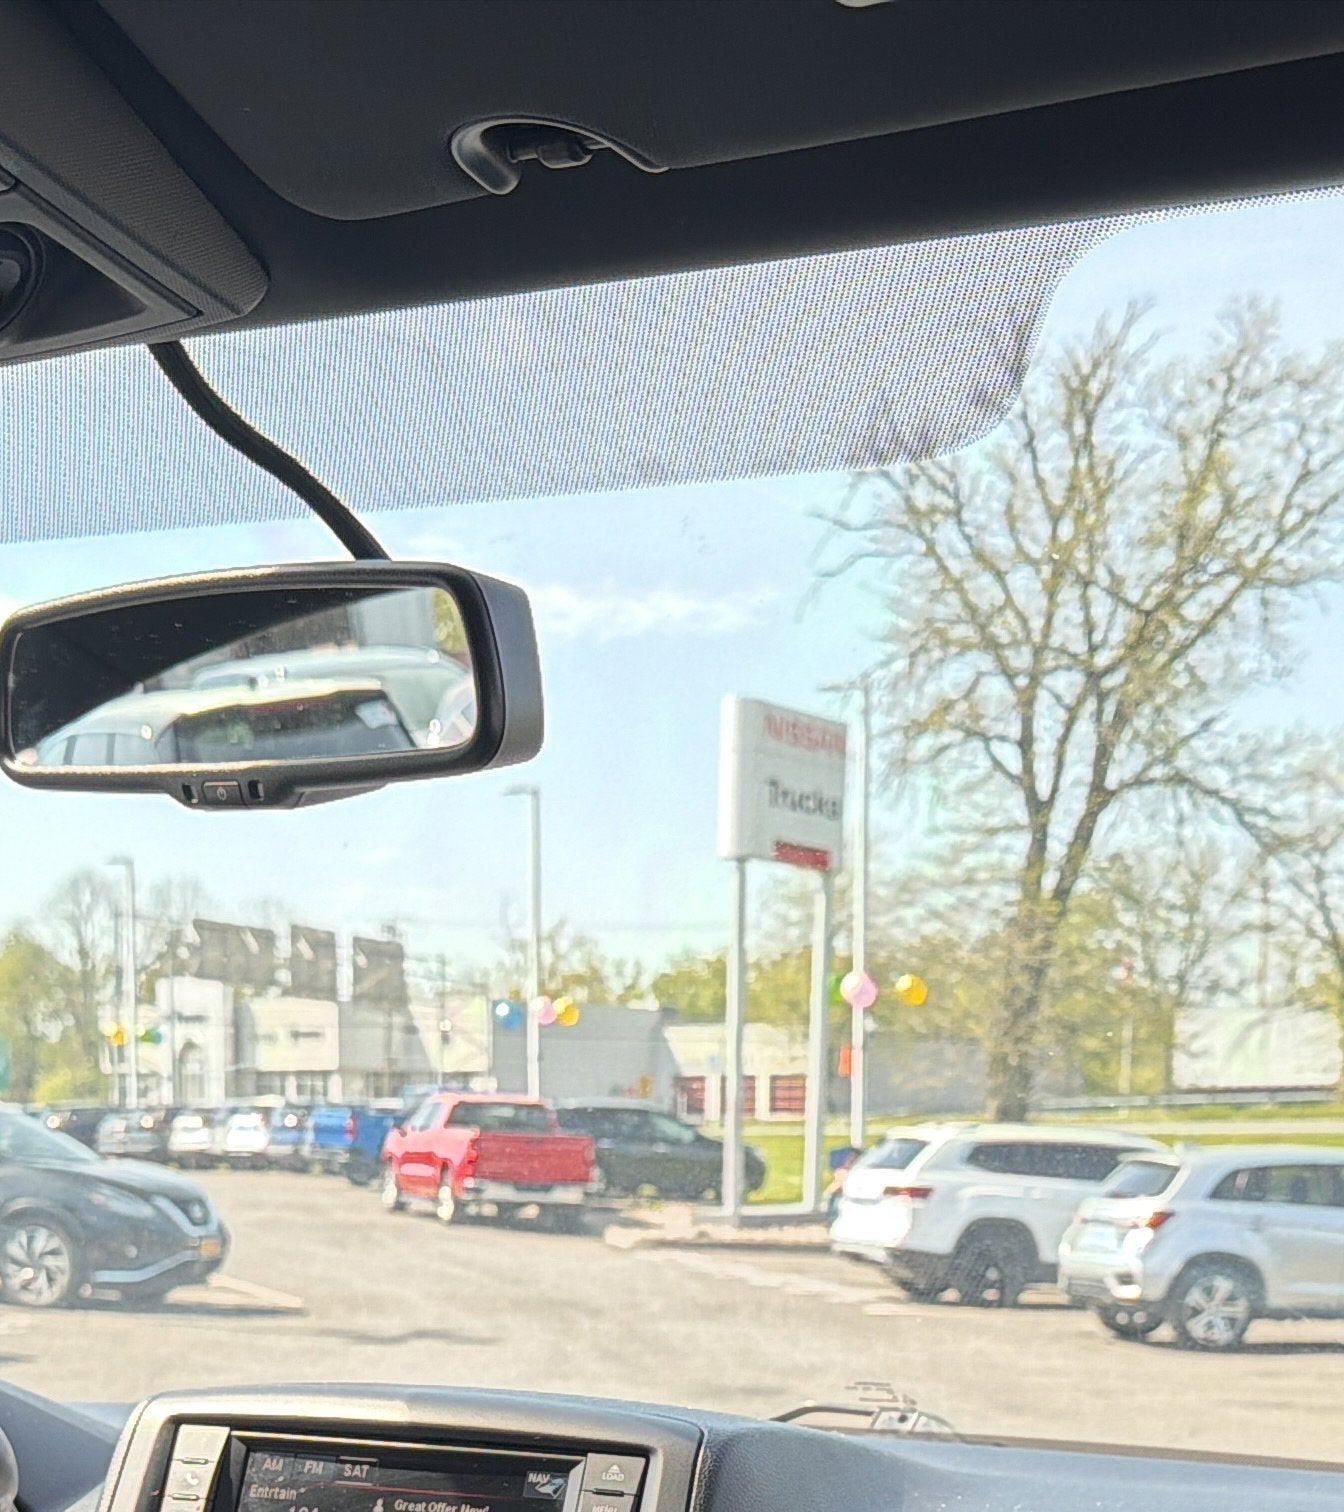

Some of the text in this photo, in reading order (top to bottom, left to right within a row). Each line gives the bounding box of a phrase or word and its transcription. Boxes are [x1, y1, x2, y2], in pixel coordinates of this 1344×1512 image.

[262, 1457, 369, 1478] AM FM SAT
[528, 1473, 550, 1483] NAV
[250, 1484, 297, 1500] Entrtain
[394, 1499, 426, 1512] Great
